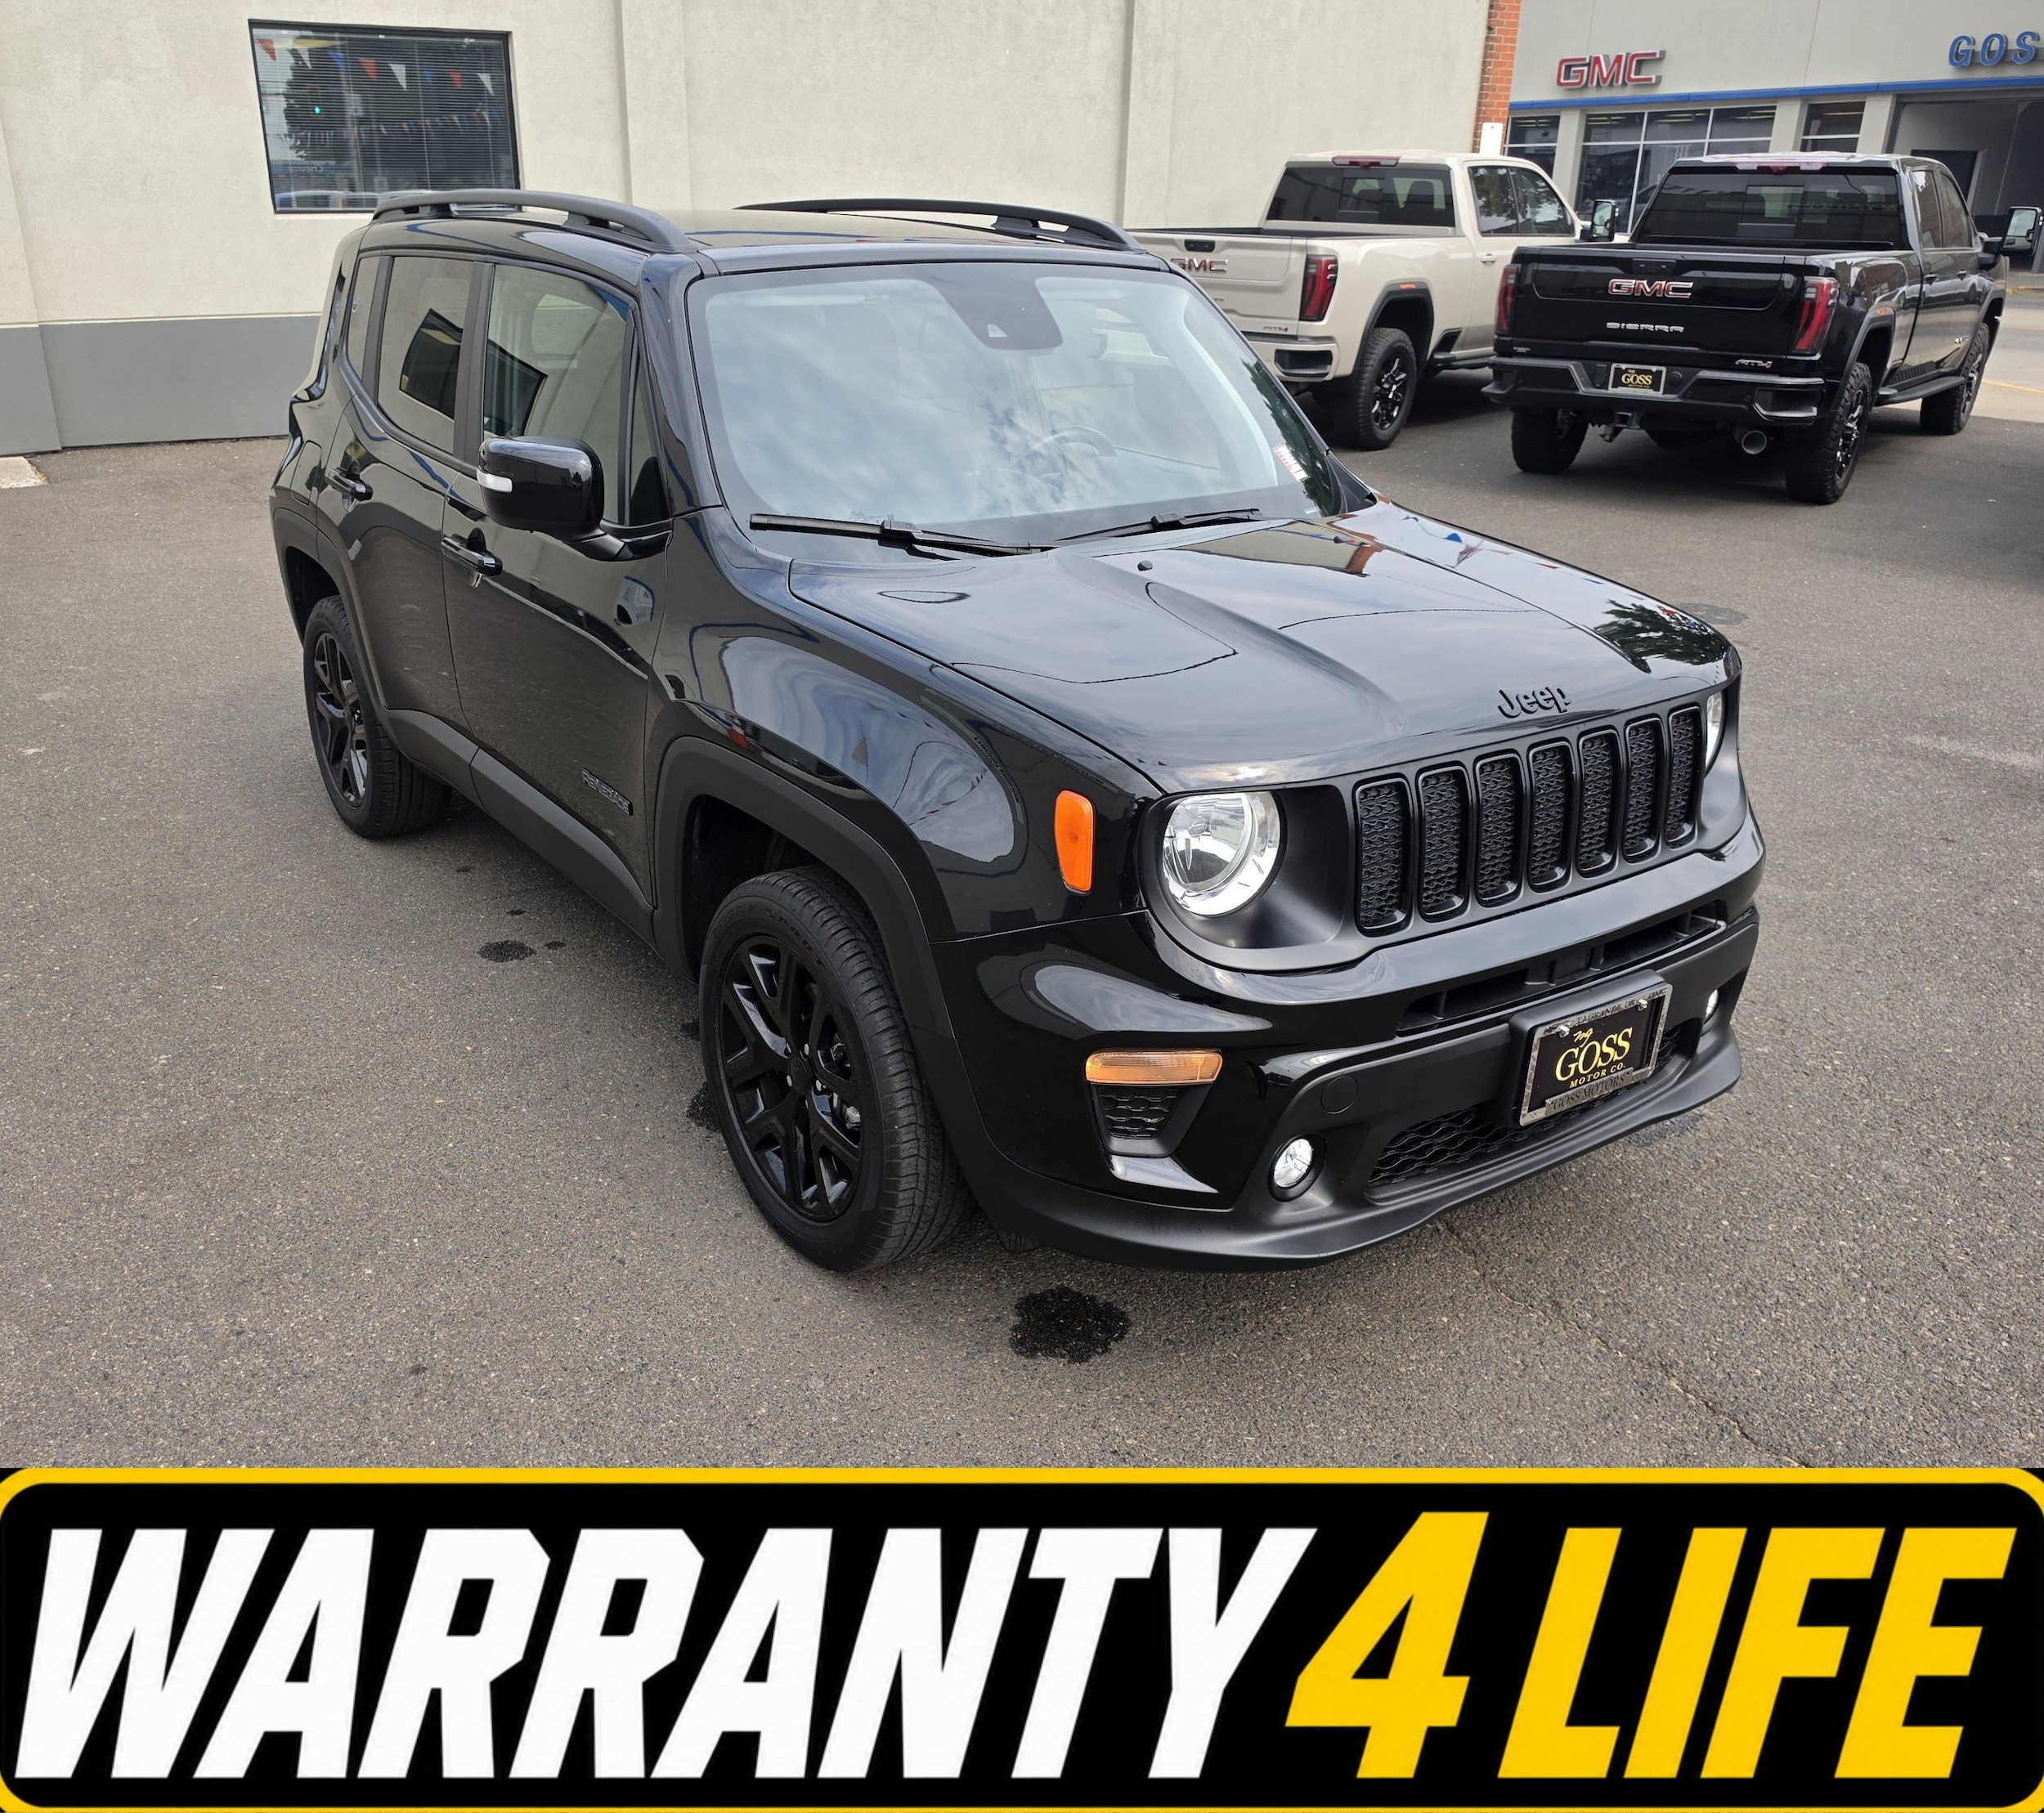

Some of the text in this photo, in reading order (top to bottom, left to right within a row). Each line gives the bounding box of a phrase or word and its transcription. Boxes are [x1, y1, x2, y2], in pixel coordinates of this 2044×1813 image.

[1948, 31, 2040, 68] GOS
[1556, 50, 1665, 88] GMC
[1608, 279, 1693, 298] GMC
[1606, 321, 1684, 333] SIERRA
[1621, 374, 1652, 385] GOSS
[1497, 685, 1571, 718] Jeep
[1555, 1027, 1633, 1081] GOSS
[1569, 1062, 1626, 1089] MOTOR CO.
